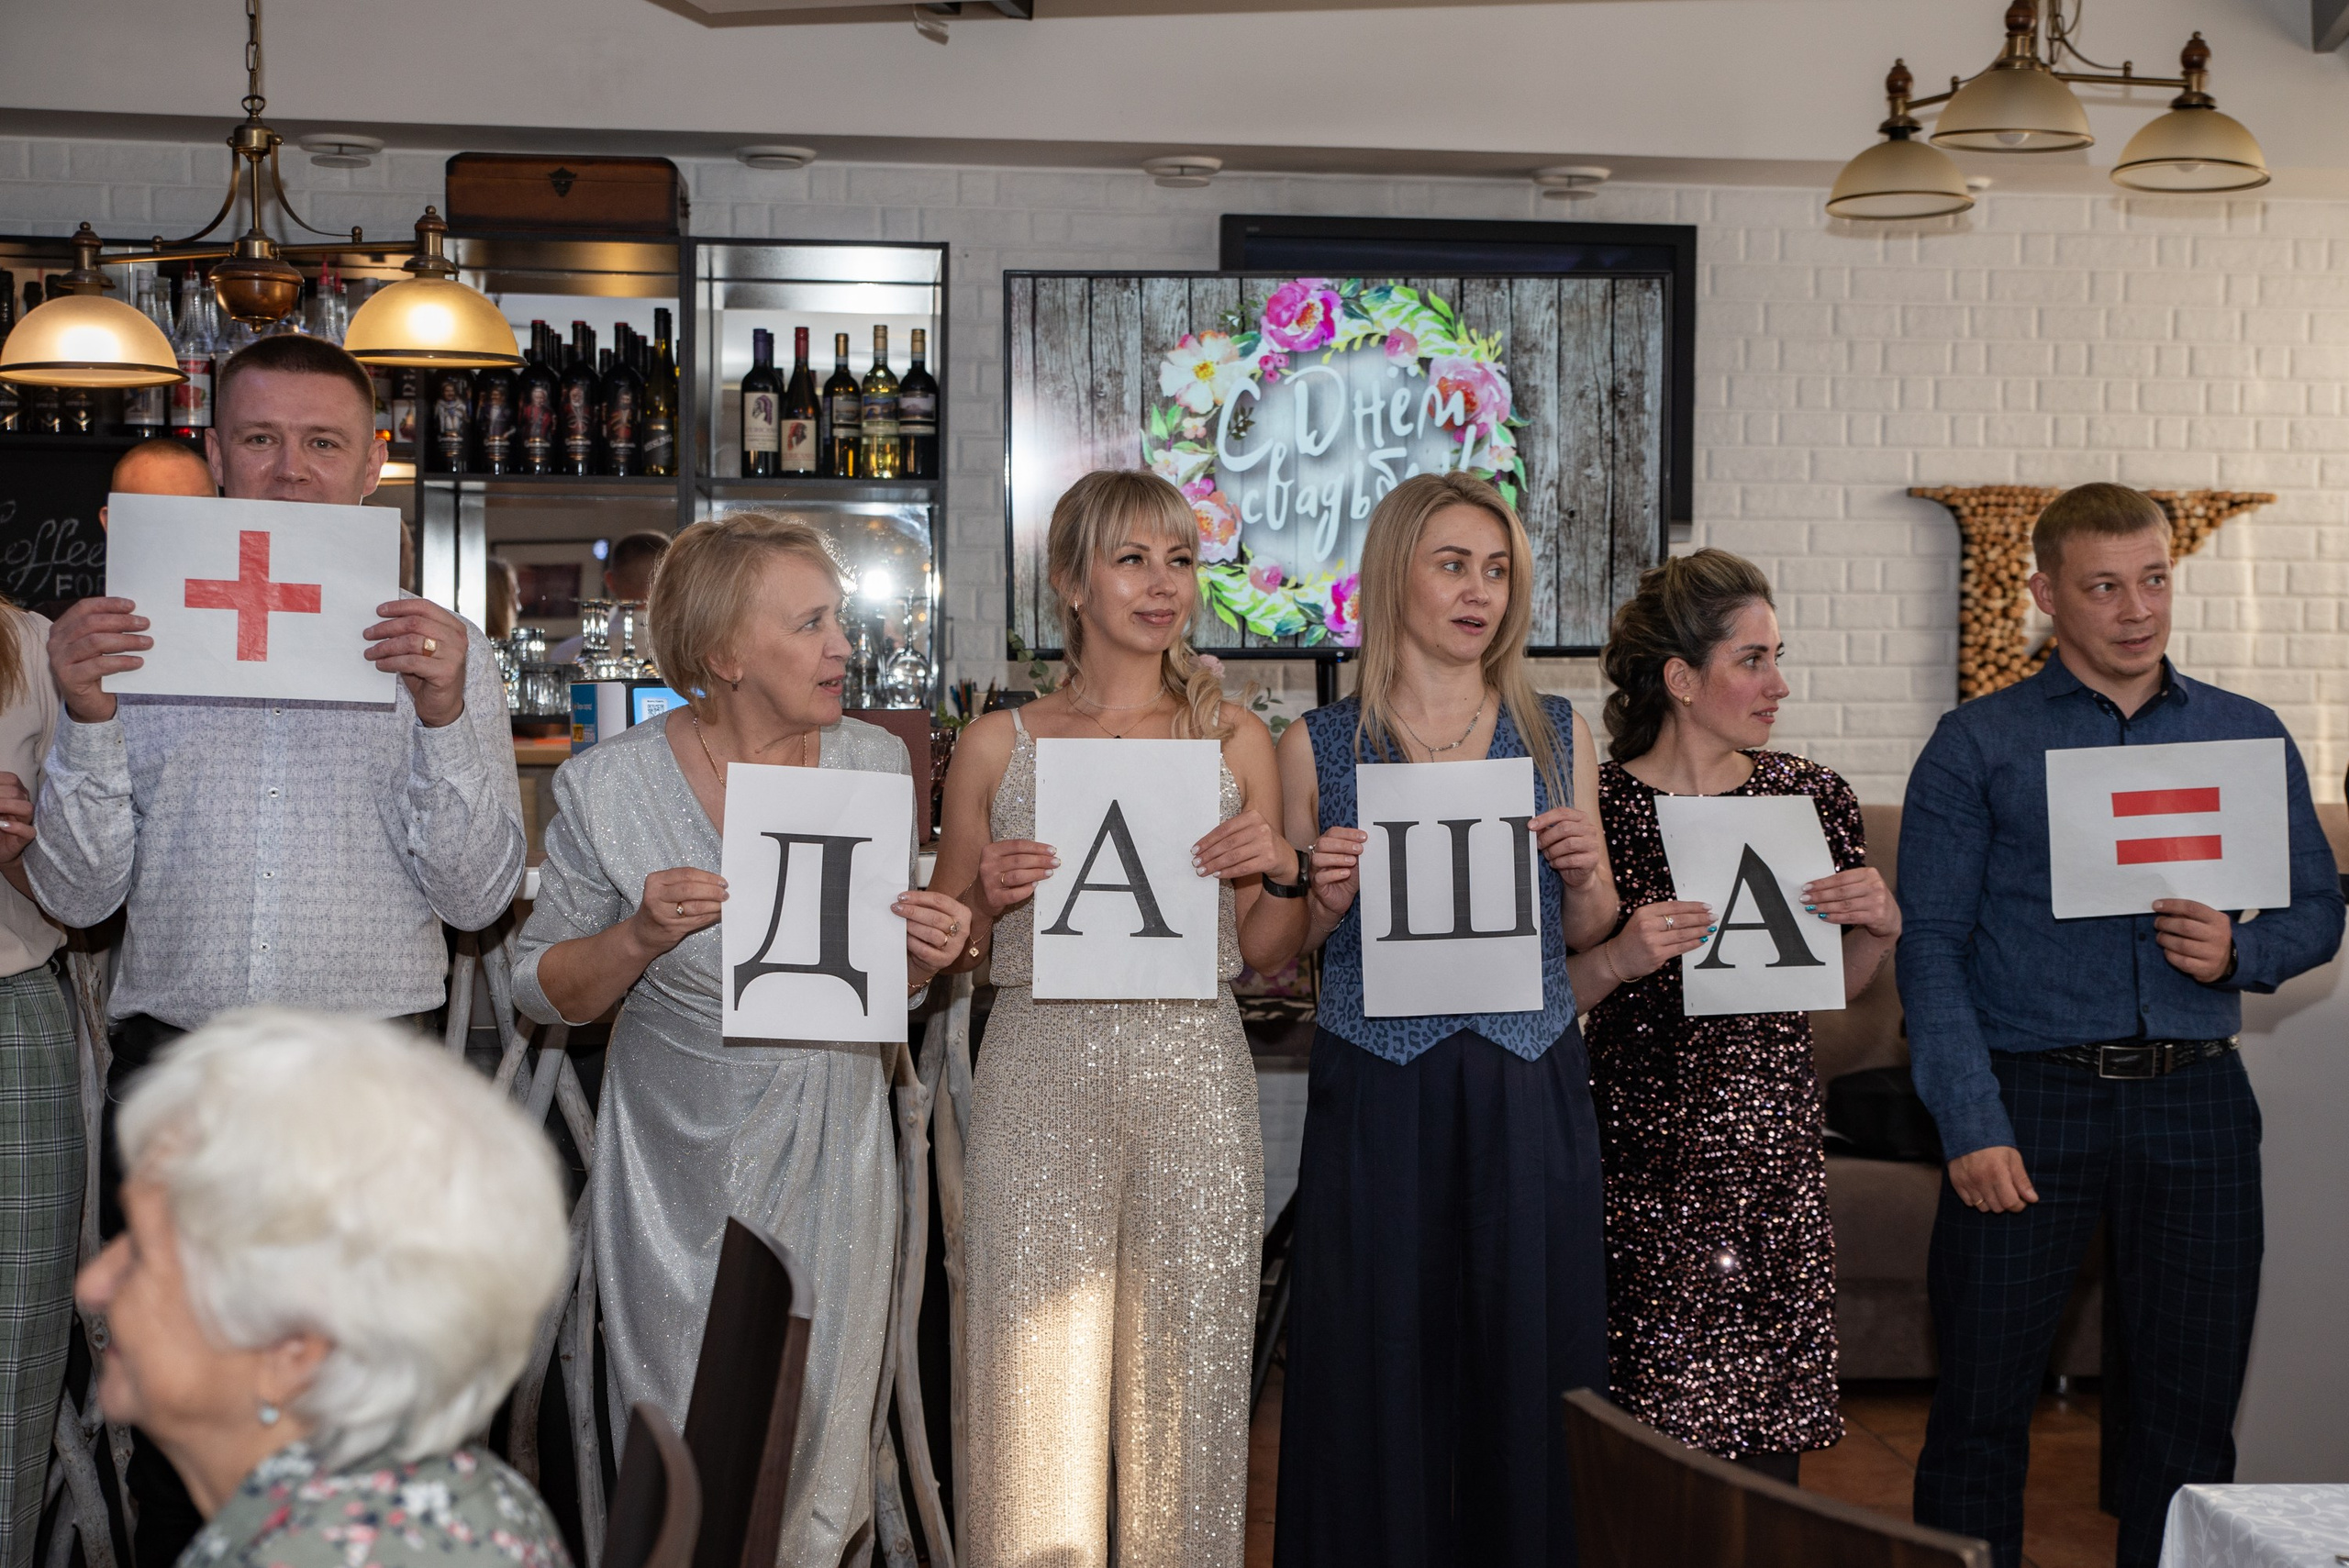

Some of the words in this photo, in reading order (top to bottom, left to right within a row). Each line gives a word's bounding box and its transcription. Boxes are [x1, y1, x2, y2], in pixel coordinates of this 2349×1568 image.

[1217, 377, 1274, 473] С
[0, 500, 107, 593] offee
[733, 831, 873, 1017] Д
[1041, 799, 1183, 938] А
[1373, 816, 1537, 941] Ш
[1694, 842, 1826, 970] А
